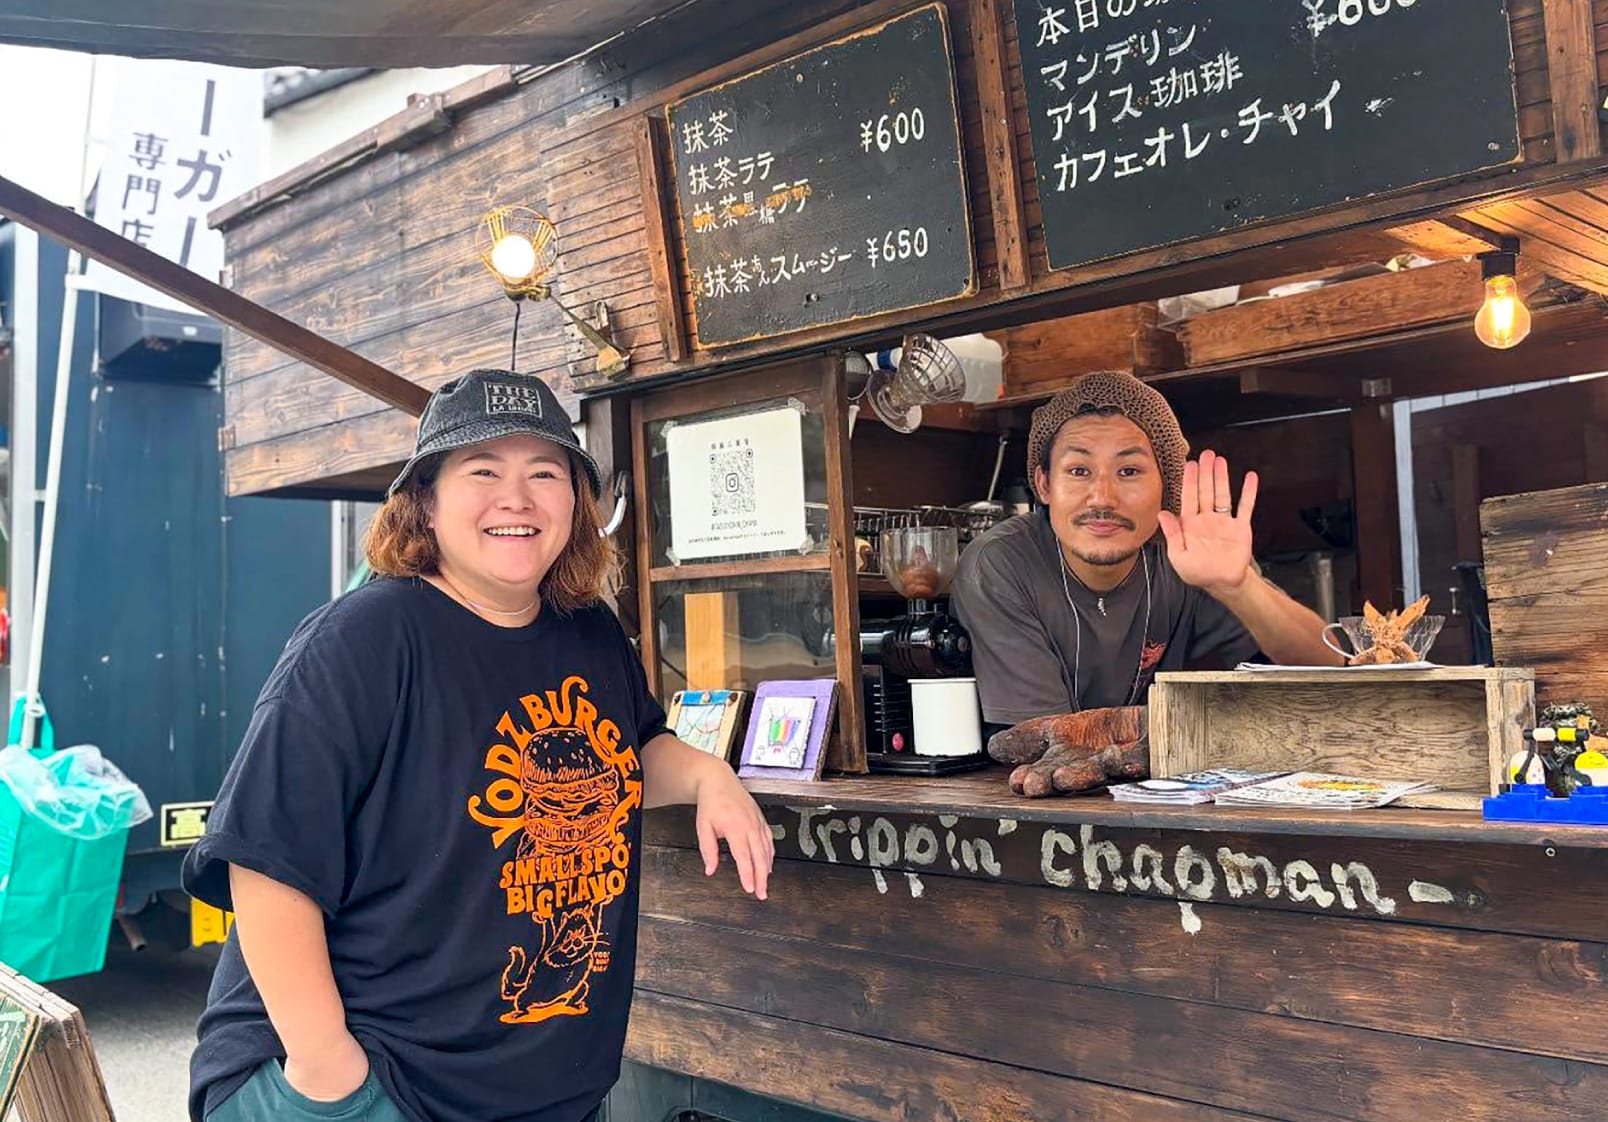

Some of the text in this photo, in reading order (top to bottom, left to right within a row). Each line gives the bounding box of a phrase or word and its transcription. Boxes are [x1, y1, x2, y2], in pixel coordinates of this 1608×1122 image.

[1036, 0, 1169, 47] 本日の
[1041, 24, 1196, 91] マンデリン
[682, 110, 733, 154] 抹茶
[860, 107, 924, 152] ¥600
[688, 152, 775, 195] 抹茶ラテ
[866, 227, 928, 268] ¥650
[468, 711, 534, 849] YODZ
[499, 843, 632, 889] SMALL SPO
[1040, 823, 1397, 935] chapman
[507, 865, 629, 918] BIG FLAVO
